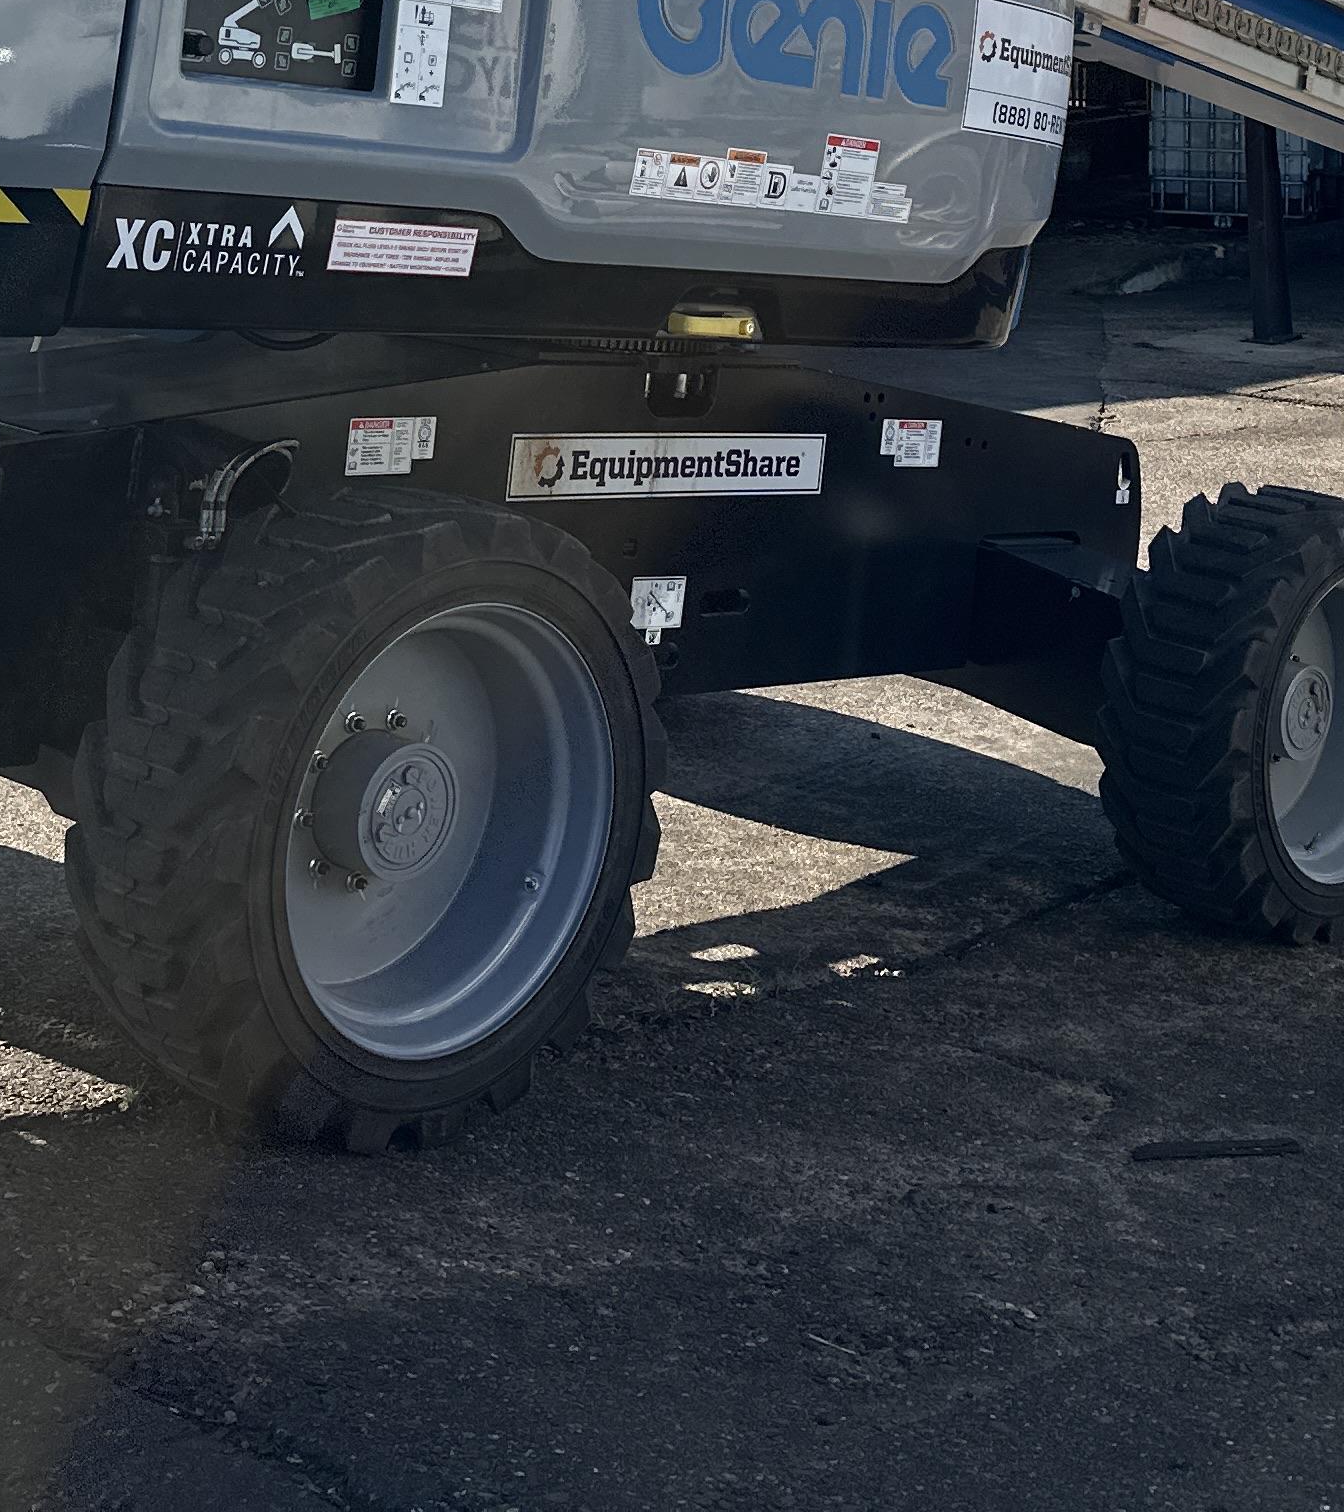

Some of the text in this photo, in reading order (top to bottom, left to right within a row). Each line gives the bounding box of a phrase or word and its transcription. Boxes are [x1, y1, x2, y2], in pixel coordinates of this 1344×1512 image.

[992, 101, 1031, 130] (888)
[106, 217, 175, 271] XC
[185, 222, 253, 248] XTRA
[368, 226, 412, 237] CUSTOMER
[413, 229, 476, 241] RESPONSIBILITY
[568, 448, 801, 487] EquipmentShare
